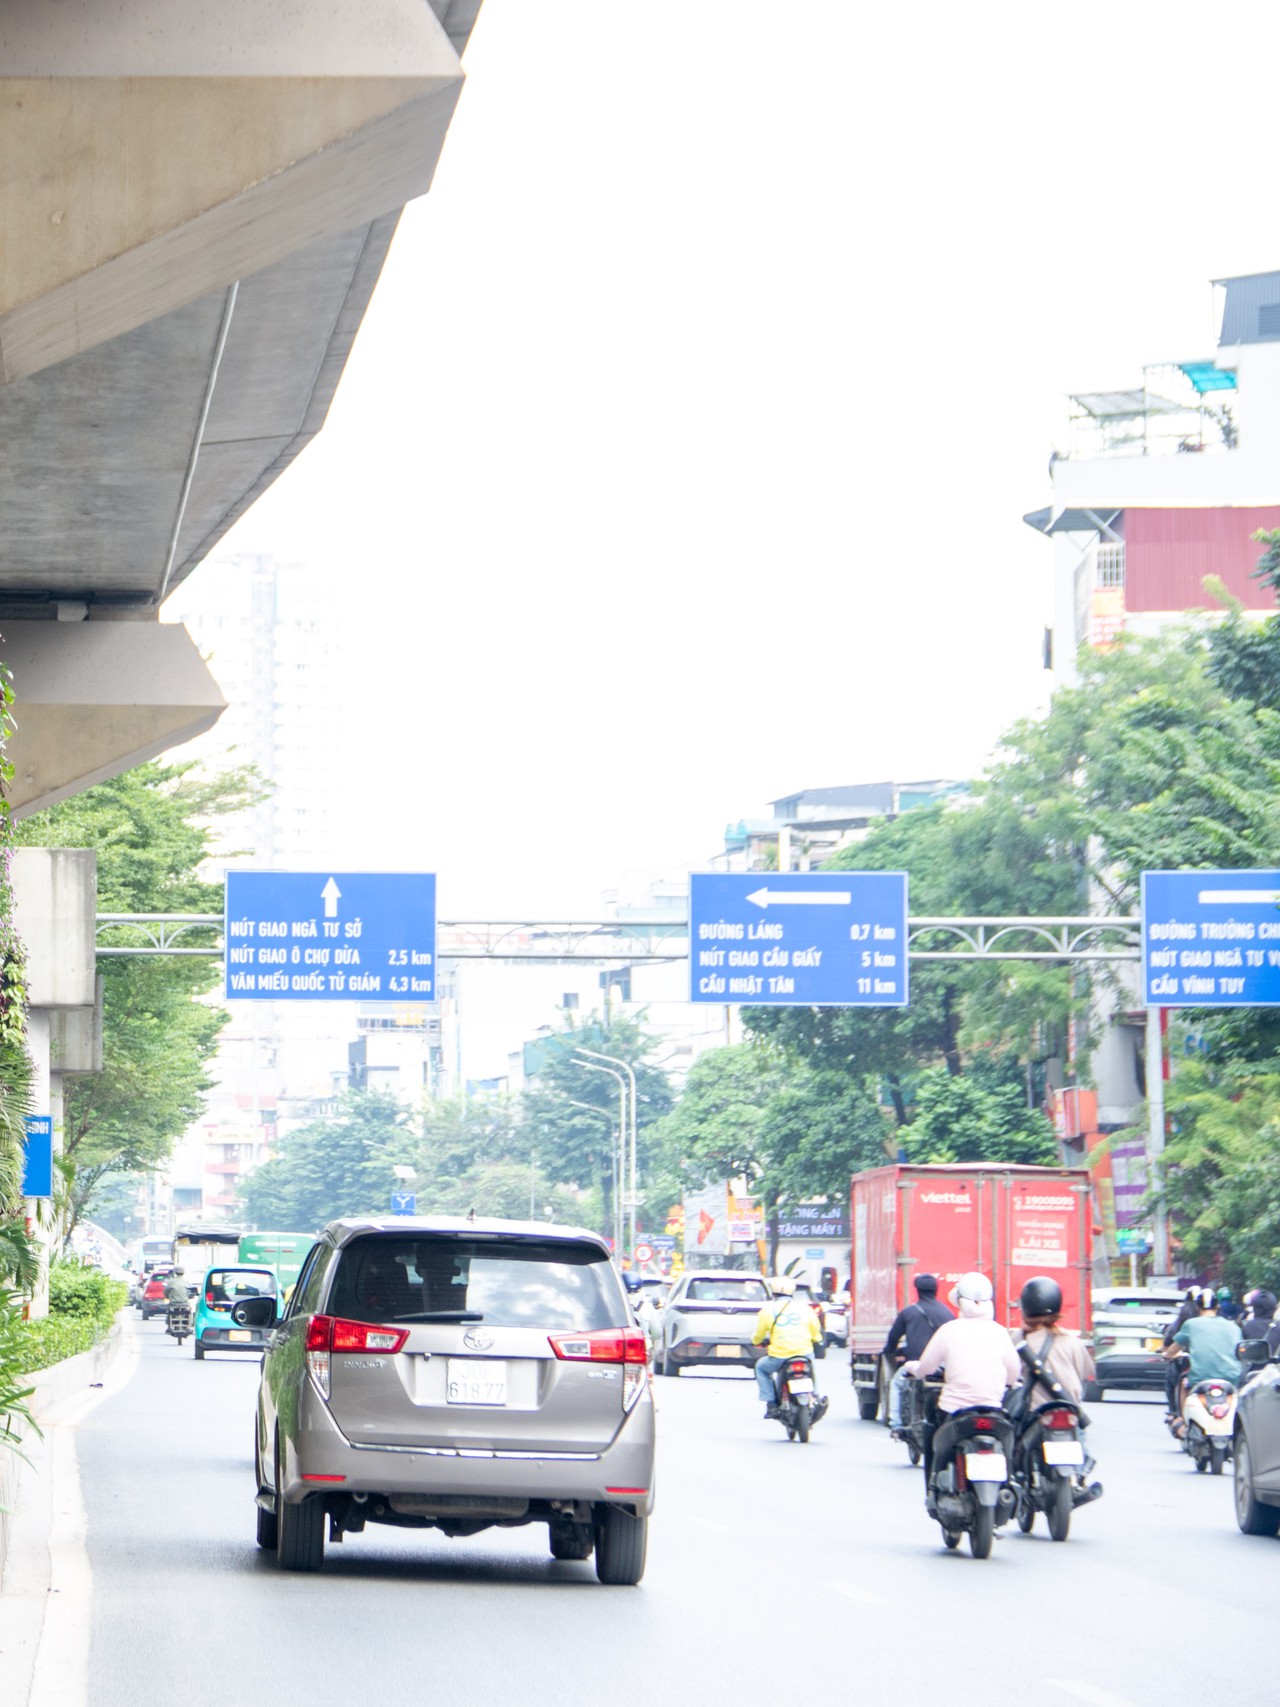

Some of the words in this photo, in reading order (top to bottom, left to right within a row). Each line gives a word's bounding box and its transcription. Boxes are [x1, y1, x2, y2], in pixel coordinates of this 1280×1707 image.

[230, 917, 255, 937] NÚT
[258, 921, 288, 938] GIAO
[292, 918, 317, 938] NGÃ
[323, 921, 340, 938] TƯ
[344, 917, 362, 938] SỞ
[698, 919, 744, 940] ĐƯỜNG
[747, 919, 783, 940] LÁNG
[850, 924, 871, 941] 0,7
[874, 925, 896, 940] km
[1149, 918, 1197, 940] ĐƯỜNG
[1200, 918, 1255, 940] TRƯỜNG
[230, 944, 255, 964] NÚT
[258, 948, 287, 964] GIAO
[291, 945, 300, 964] Ô
[304, 948, 330, 967] CHỢ
[334, 944, 360, 964] DỪA
[388, 949, 408, 966] 2,5
[411, 950, 432, 965] km
[699, 946, 726, 967] NÚT
[728, 950, 759, 967] GIAO
[762, 946, 789, 967] CẦU
[792, 946, 822, 967] GIẤY
[861, 951, 871, 967] 5
[874, 952, 896, 967] km
[1150, 946, 1178, 967] NÚT
[1180, 950, 1212, 968] GIAO
[1214, 947, 1243, 967] NGÃ
[1245, 949, 1266, 967] TƯ
[231, 972, 255, 990] VĂN
[258, 970, 289, 990] MIẾU
[292, 970, 325, 991] QUỐC
[328, 971, 345, 991] TỬ
[349, 972, 381, 991] GIÁM
[389, 976, 408, 992] 4,3
[411, 977, 431, 992] km
[699, 973, 726, 994] CẦU
[729, 975, 763, 995] NHẬT
[768, 975, 795, 994] TÂN
[857, 978, 871, 994] 11
[874, 979, 896, 994] km
[1182, 974, 1215, 995] VĨNH
[920, 1191, 973, 1204] viettel
